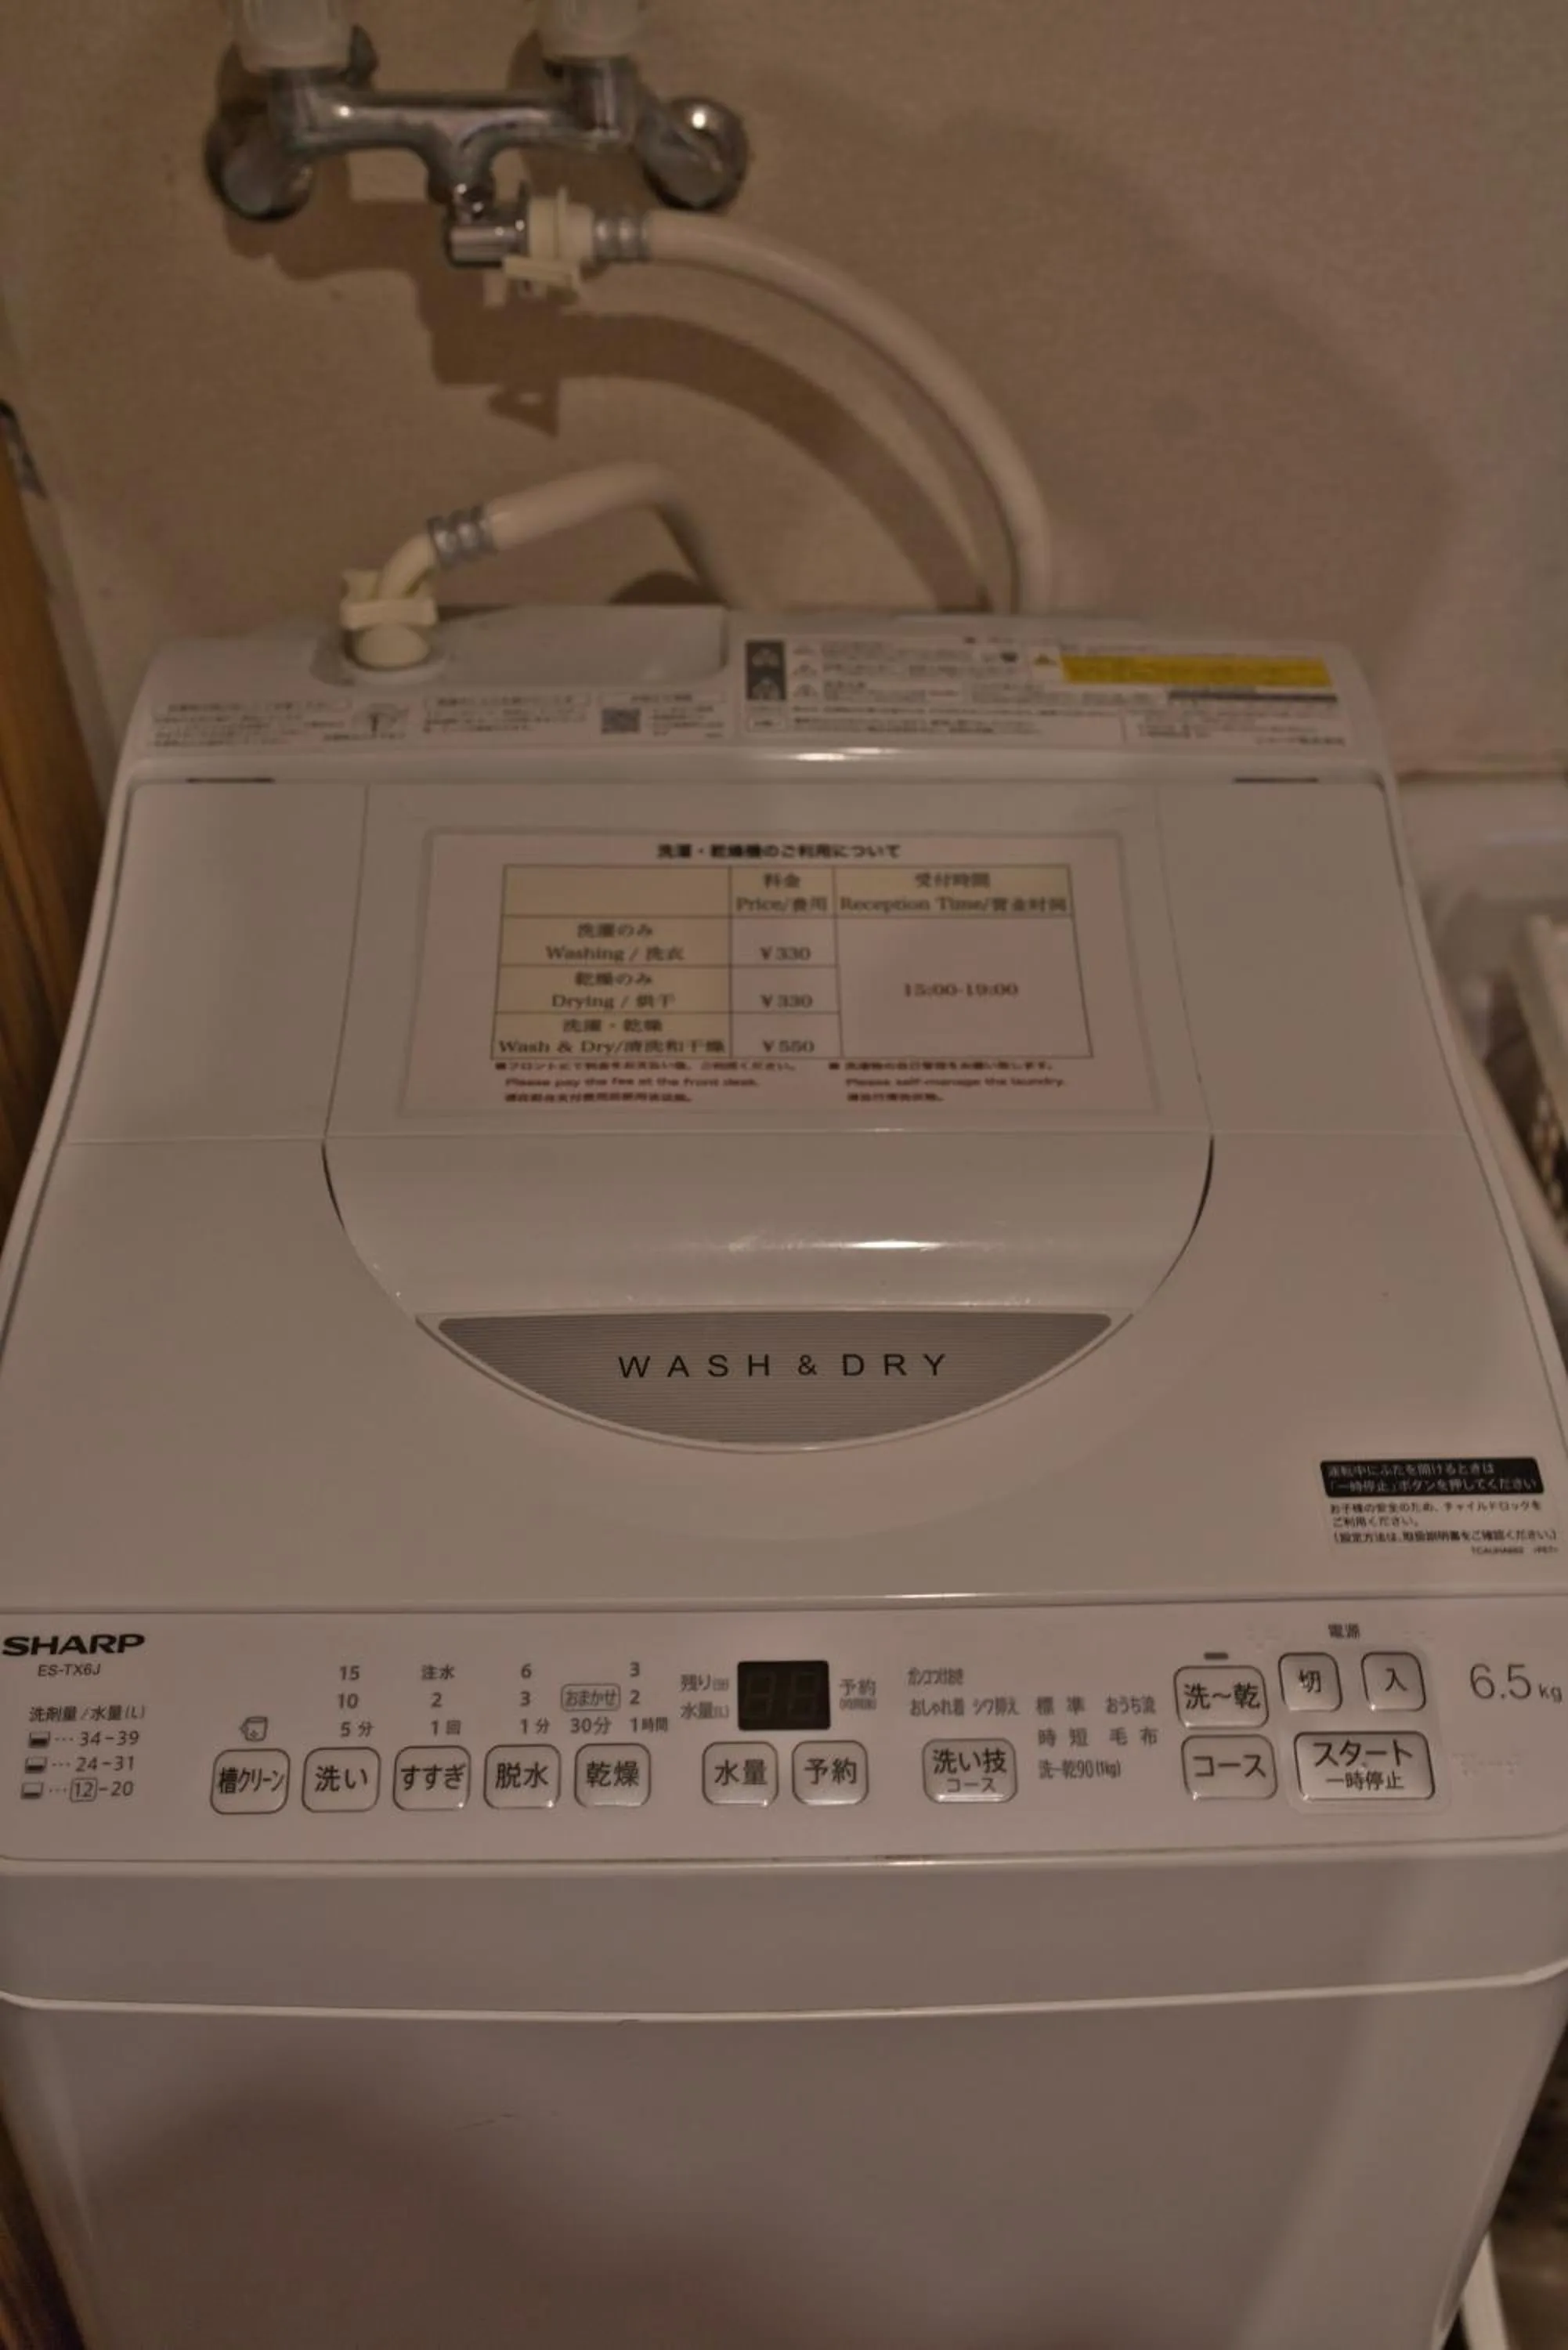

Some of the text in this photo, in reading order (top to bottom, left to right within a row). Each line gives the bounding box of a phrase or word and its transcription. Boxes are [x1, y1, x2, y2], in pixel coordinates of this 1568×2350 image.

[840, 896, 930, 913] Reception
[545, 945, 625, 963] Washing
[551, 993, 616, 1010] Drying
[498, 1040, 551, 1054] Wash
[556, 1040, 573, 1054] &
[618, 1353, 946, 1378] WASH & DRY
[1328, 1623, 1360, 1640] 電源
[2, 1633, 146, 1656] SHARP
[37, 1663, 101, 1677] ES-TX6J
[339, 1665, 360, 1680] 15
[421, 1665, 456, 1680] 注水
[520, 1663, 533, 1679] 6
[630, 1661, 641, 1677] 3
[840, 1677, 876, 1696] 予約
[1298, 1669, 1321, 1694] 切
[1384, 1667, 1407, 1691] 入
[338, 1694, 359, 1709] 10
[431, 1693, 443, 1708] 2
[520, 1691, 531, 1707] 3
[565, 1690, 617, 1706] おまかせ
[630, 1690, 641, 1705] 2
[931, 1748, 1008, 1775] 洗い技
[1313, 1739, 1414, 1768] スタート
[714, 1759, 768, 1787] 水量
[804, 1758, 858, 1785] 予約
[1192, 1752, 1267, 1778] コース
[218, 1767, 284, 1794] 槽クリーン
[314, 1764, 369, 1792] 洗い
[400, 1762, 467, 1791] すすぎ
[494, 1762, 549, 1789] 脱水
[586, 1761, 640, 1788] 乾燥
[1326, 1772, 1405, 1792] 一時停止
[946, 1777, 997, 1794] コース
